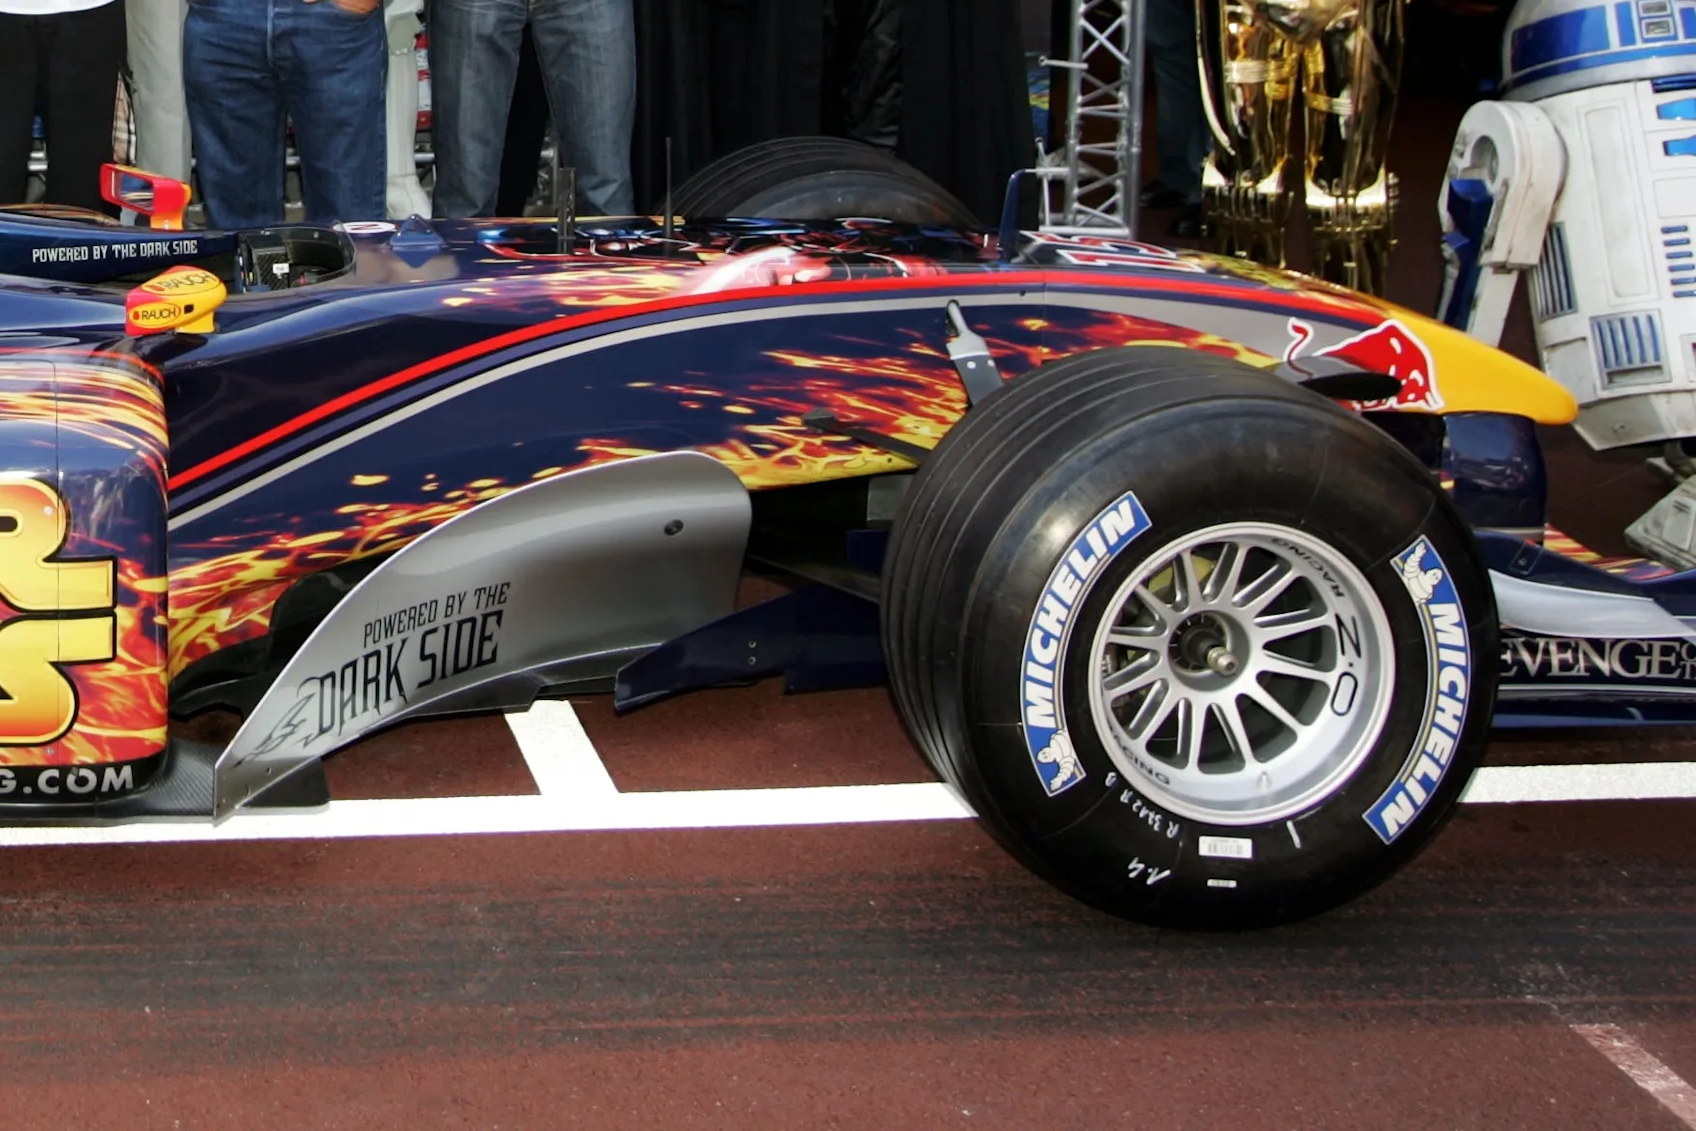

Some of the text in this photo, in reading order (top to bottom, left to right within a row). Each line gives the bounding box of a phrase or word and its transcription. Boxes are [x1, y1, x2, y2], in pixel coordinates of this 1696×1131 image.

[32, 239, 198, 263] POWERED BY THE DARK SIDE
[161, 273, 217, 291] RAUCH
[141, 306, 176, 321] RAUCH
[1271, 538, 1345, 598] RACING
[363, 582, 511, 648] POWERED BY THE
[1025, 499, 1136, 729] MICHELIN
[310, 609, 503, 742] DARK SIDE
[1380, 602, 1468, 837] MICHELIN
